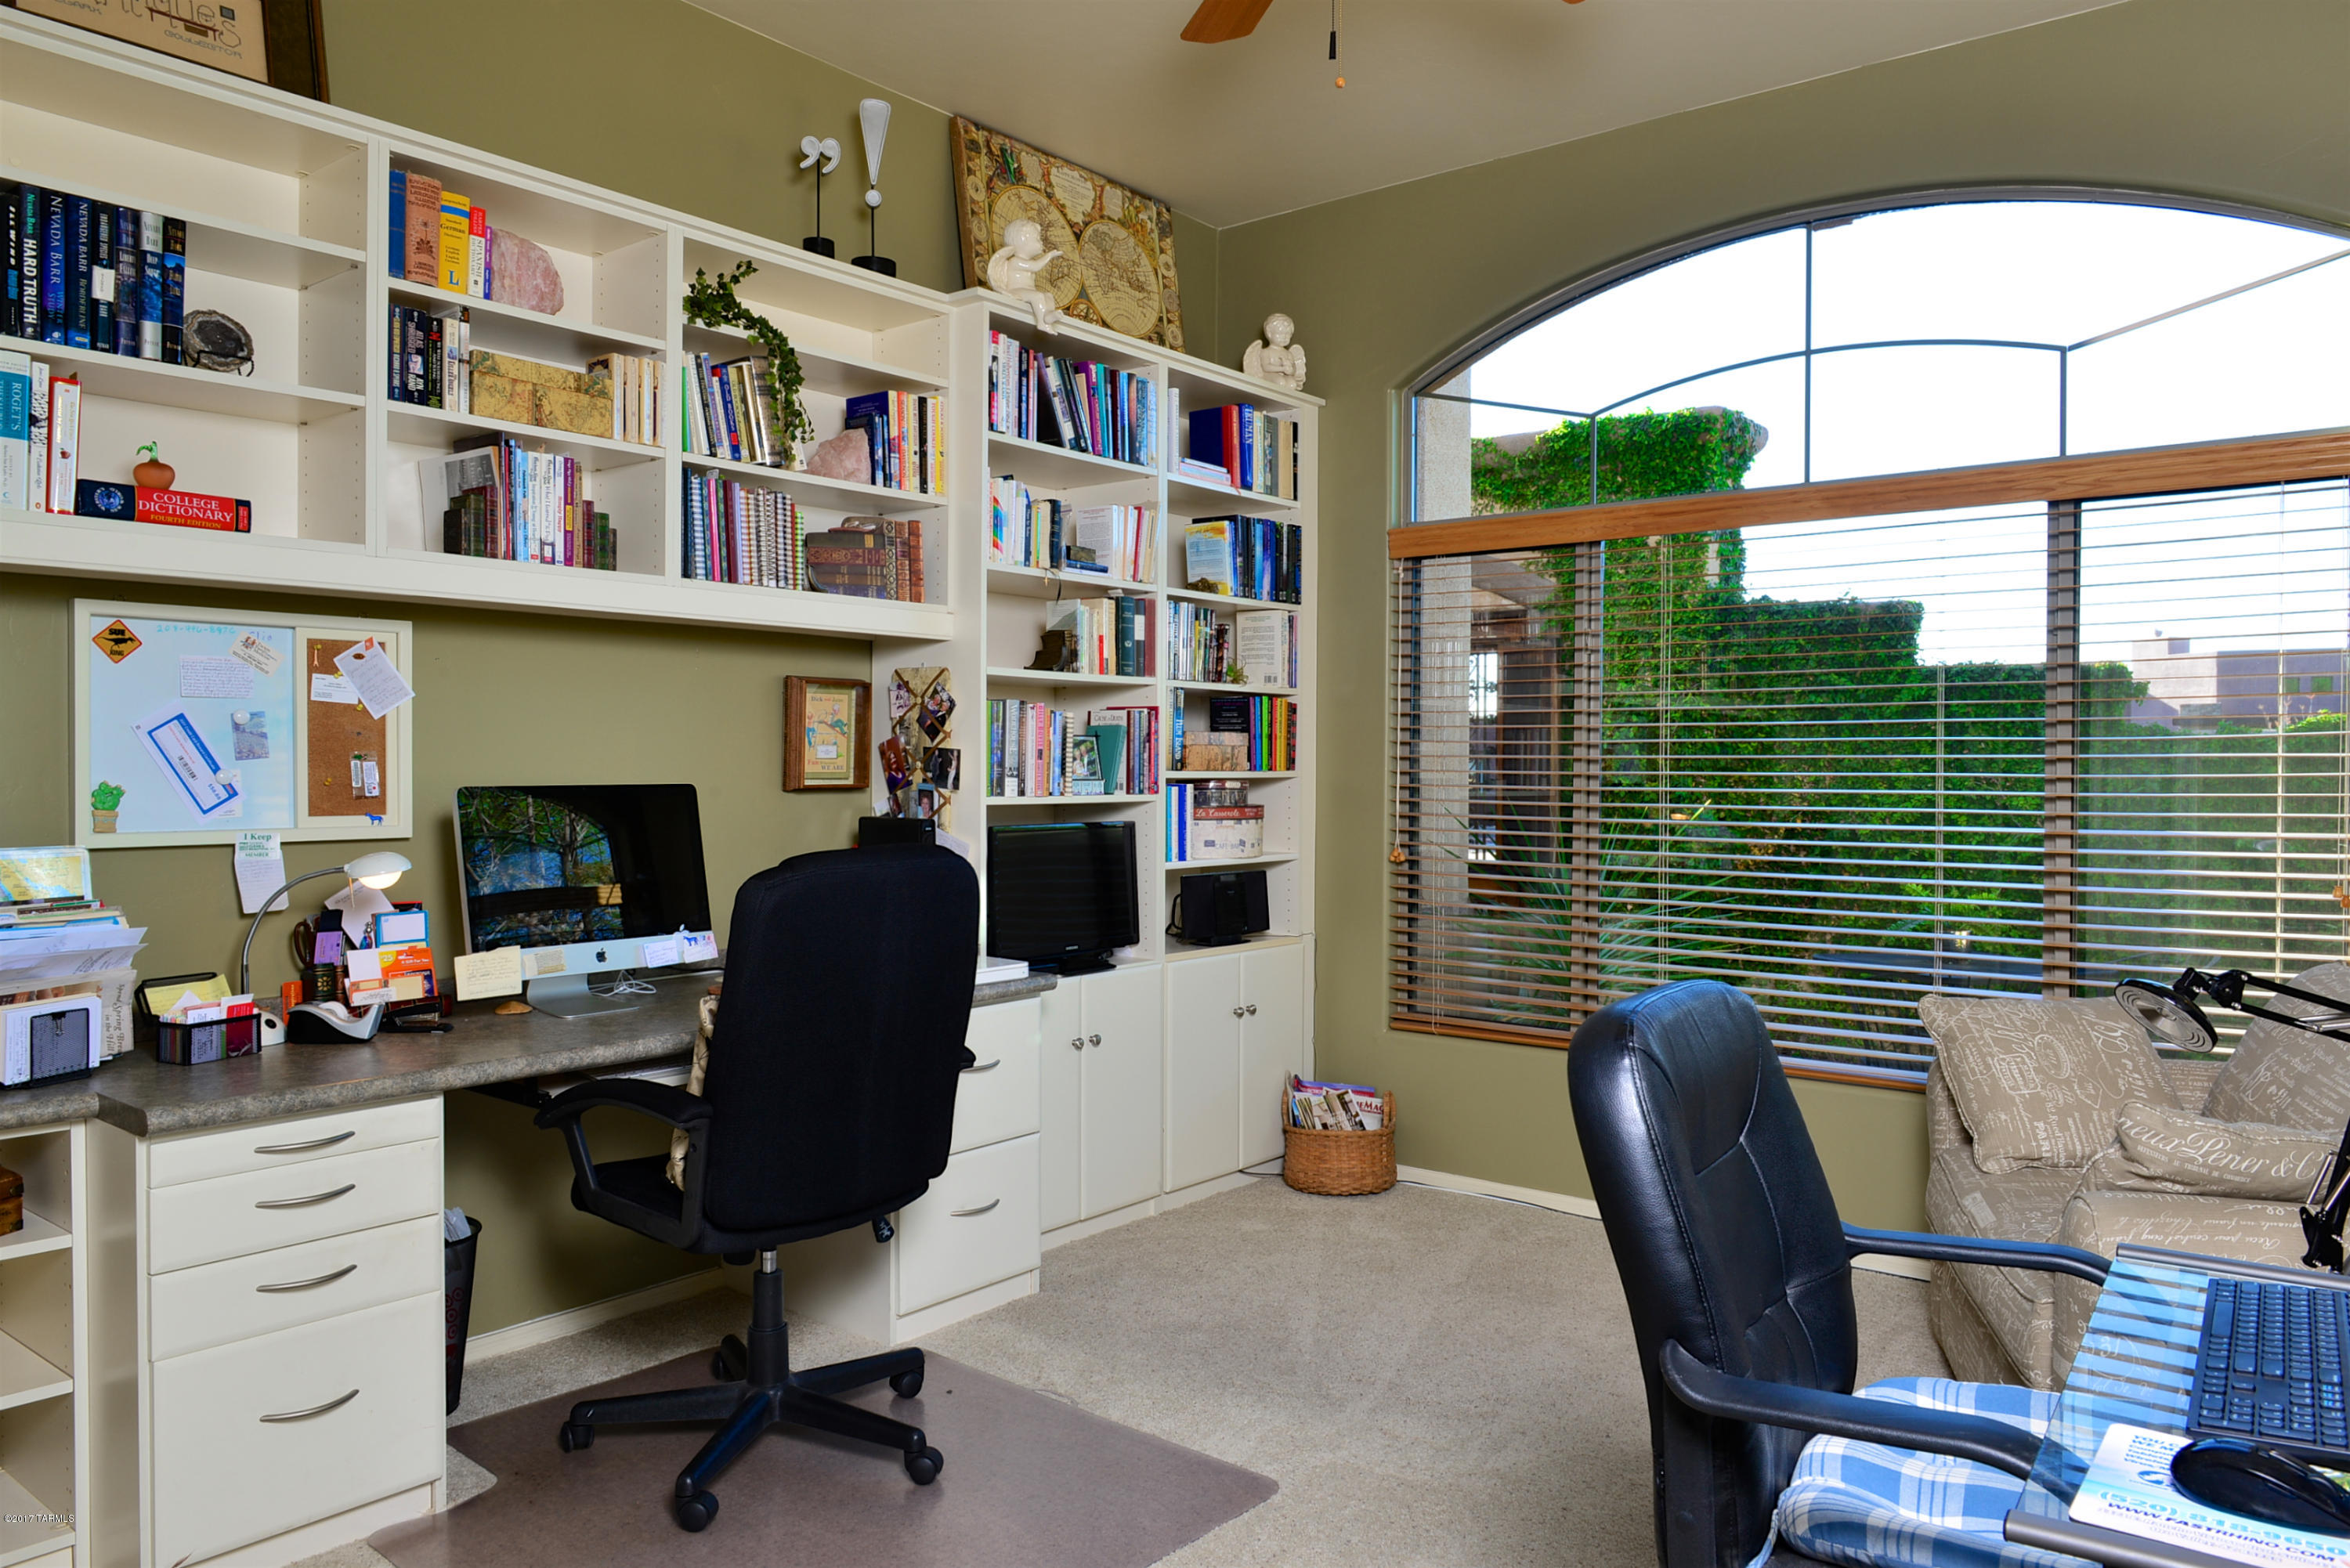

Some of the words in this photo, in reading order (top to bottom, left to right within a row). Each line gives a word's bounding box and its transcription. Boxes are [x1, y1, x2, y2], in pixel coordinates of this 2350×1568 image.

[26, 193, 36, 217] NEVADA
[26, 218, 35, 234] BARR
[50, 196, 63, 246] NEVADA
[78, 201, 88, 242] NEVADA
[440, 223, 466, 234] German
[24, 238, 37, 276] HARD
[50, 252, 63, 284] BARR
[78, 245, 88, 272] BARR
[448, 270, 459, 286] L
[24, 279, 38, 323] TRUTH
[47, 293, 56, 319] STUDY
[78, 278, 88, 329] BORDERLINE
[408, 322, 416, 354] SHRUGGED
[12, 382, 22, 431] ROGET'S
[1245, 407, 1253, 444] TRUMAN
[138, 500, 234, 522] DICTIONARY
[153, 492, 220, 510] COLLEGE
[150, 514, 185, 524] FOURTH
[187, 519, 221, 529] EDITION
[108, 628, 126, 636] SUE
[1009, 705, 1018, 754] WODEHOUSE
[1175, 737, 1183, 759] ISLAND
[1196, 808, 1206, 817] La
[1209, 808, 1240, 817] Casserole
[251, 833, 272, 842] Keep
[117, 984, 125, 1003] Spend
[112, 1003, 124, 1031] Spring
[2131, 1439, 2156, 1448] WE
[2134, 1434, 2165, 1445] YOU
[2099, 1491, 2178, 1516] (520)
[2107, 1502, 2336, 1563] WWW.FASTRHINO.COM
